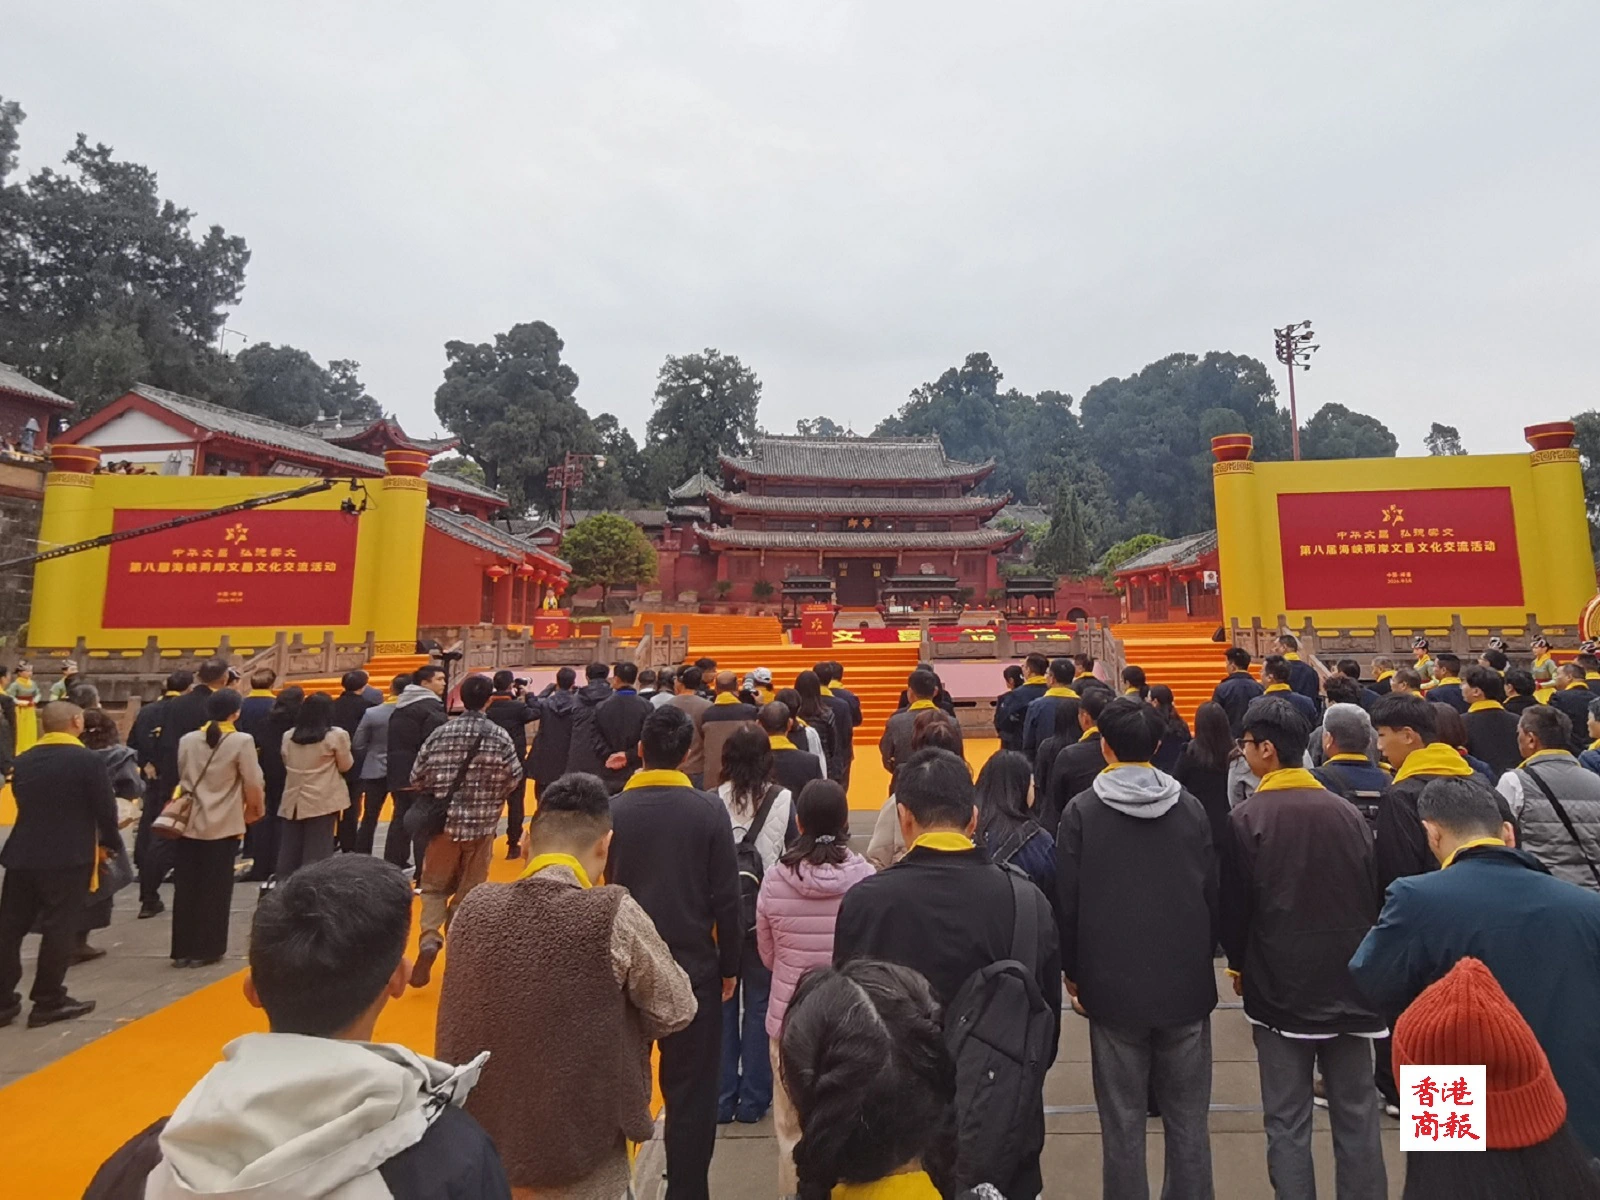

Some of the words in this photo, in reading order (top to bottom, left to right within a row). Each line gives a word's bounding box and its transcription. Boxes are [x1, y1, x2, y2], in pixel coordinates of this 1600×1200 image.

[1299, 540, 1496, 557] 第八届海峡两岸文昌文化交流活动
[129, 562, 337, 574] 第八届海峡两岸文昌文化交流活动
